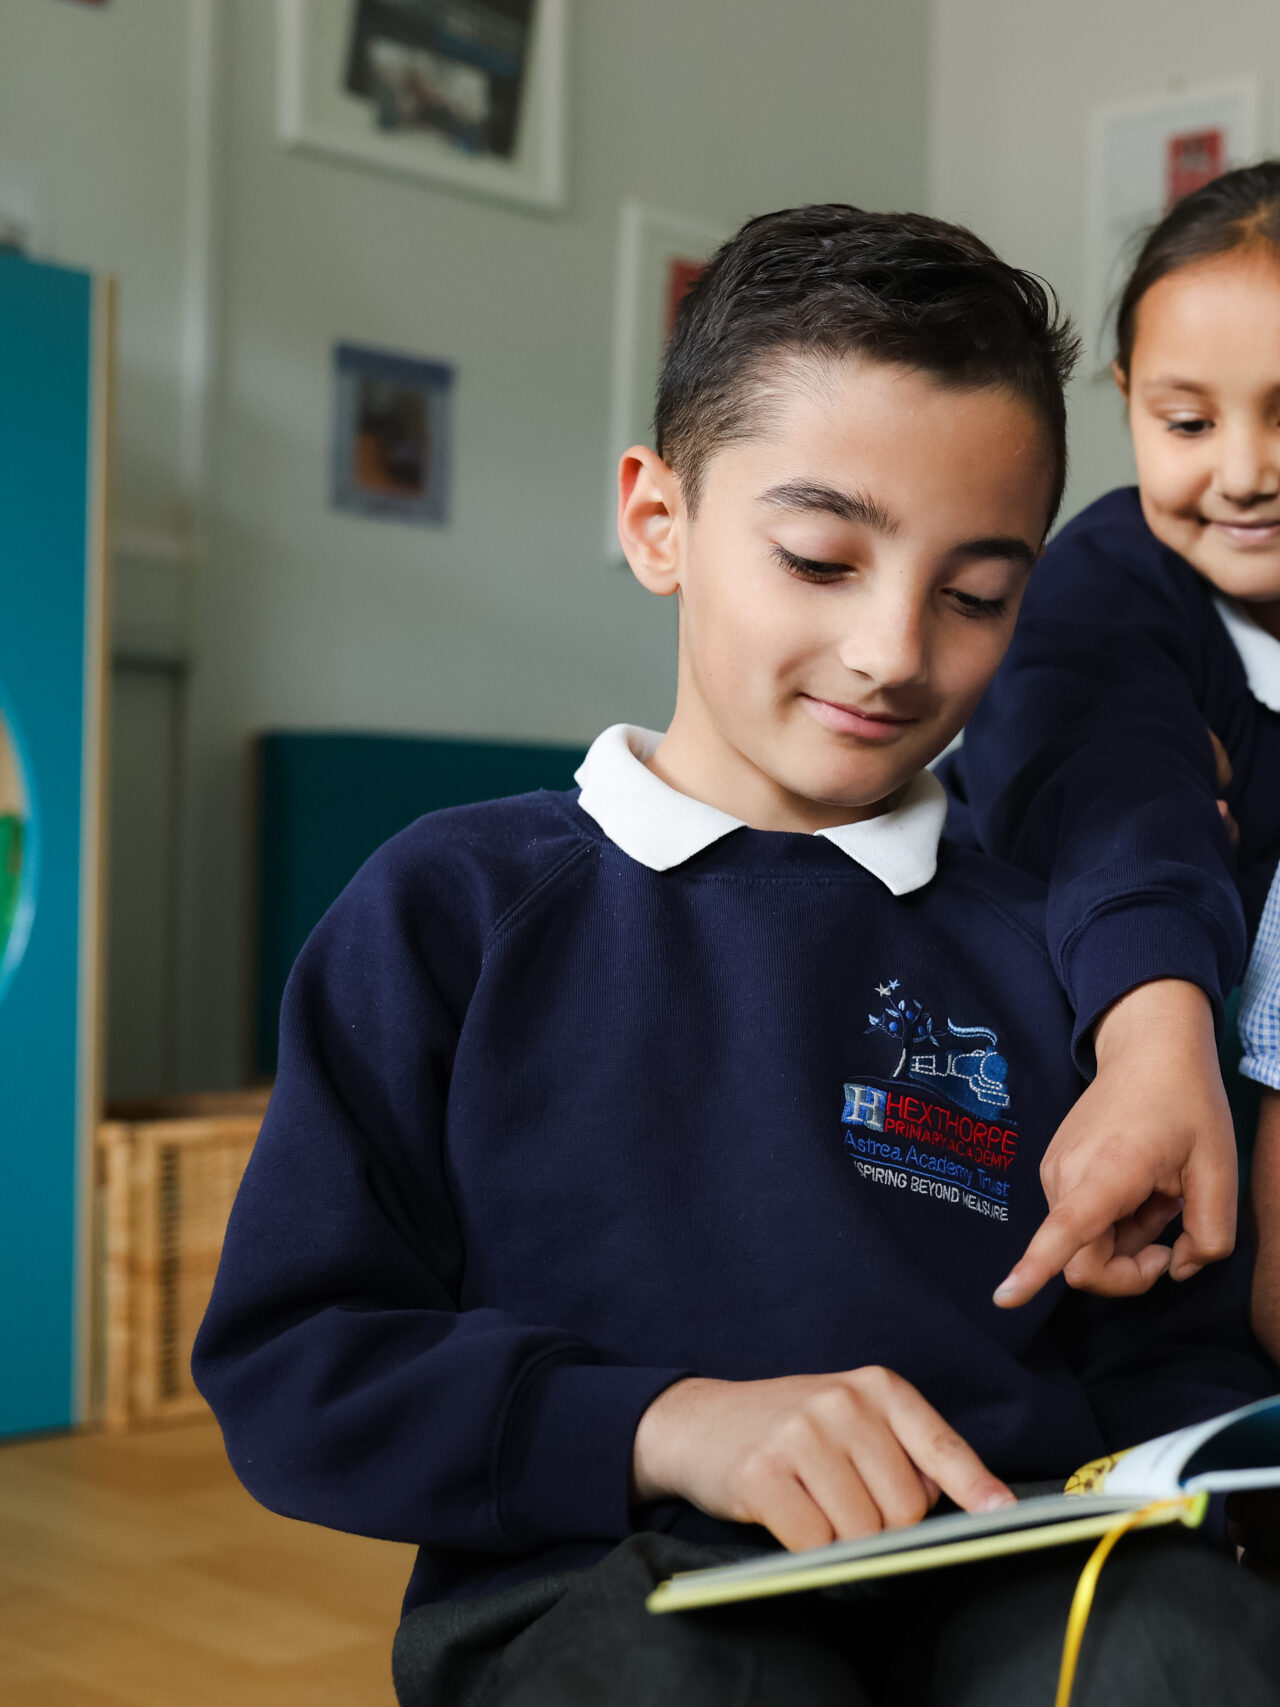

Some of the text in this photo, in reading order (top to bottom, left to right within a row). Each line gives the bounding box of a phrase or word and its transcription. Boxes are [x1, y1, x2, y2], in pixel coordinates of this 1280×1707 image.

[885, 1118, 1014, 1172] PRIMARY ACADEMY
[886, 1091, 1019, 1156] HEXTHORPE
[845, 1129, 1010, 1197] Astrea Academy Trust
[854, 1160, 908, 1188] SPIRING
[911, 1176, 960, 1203] BEYOND
